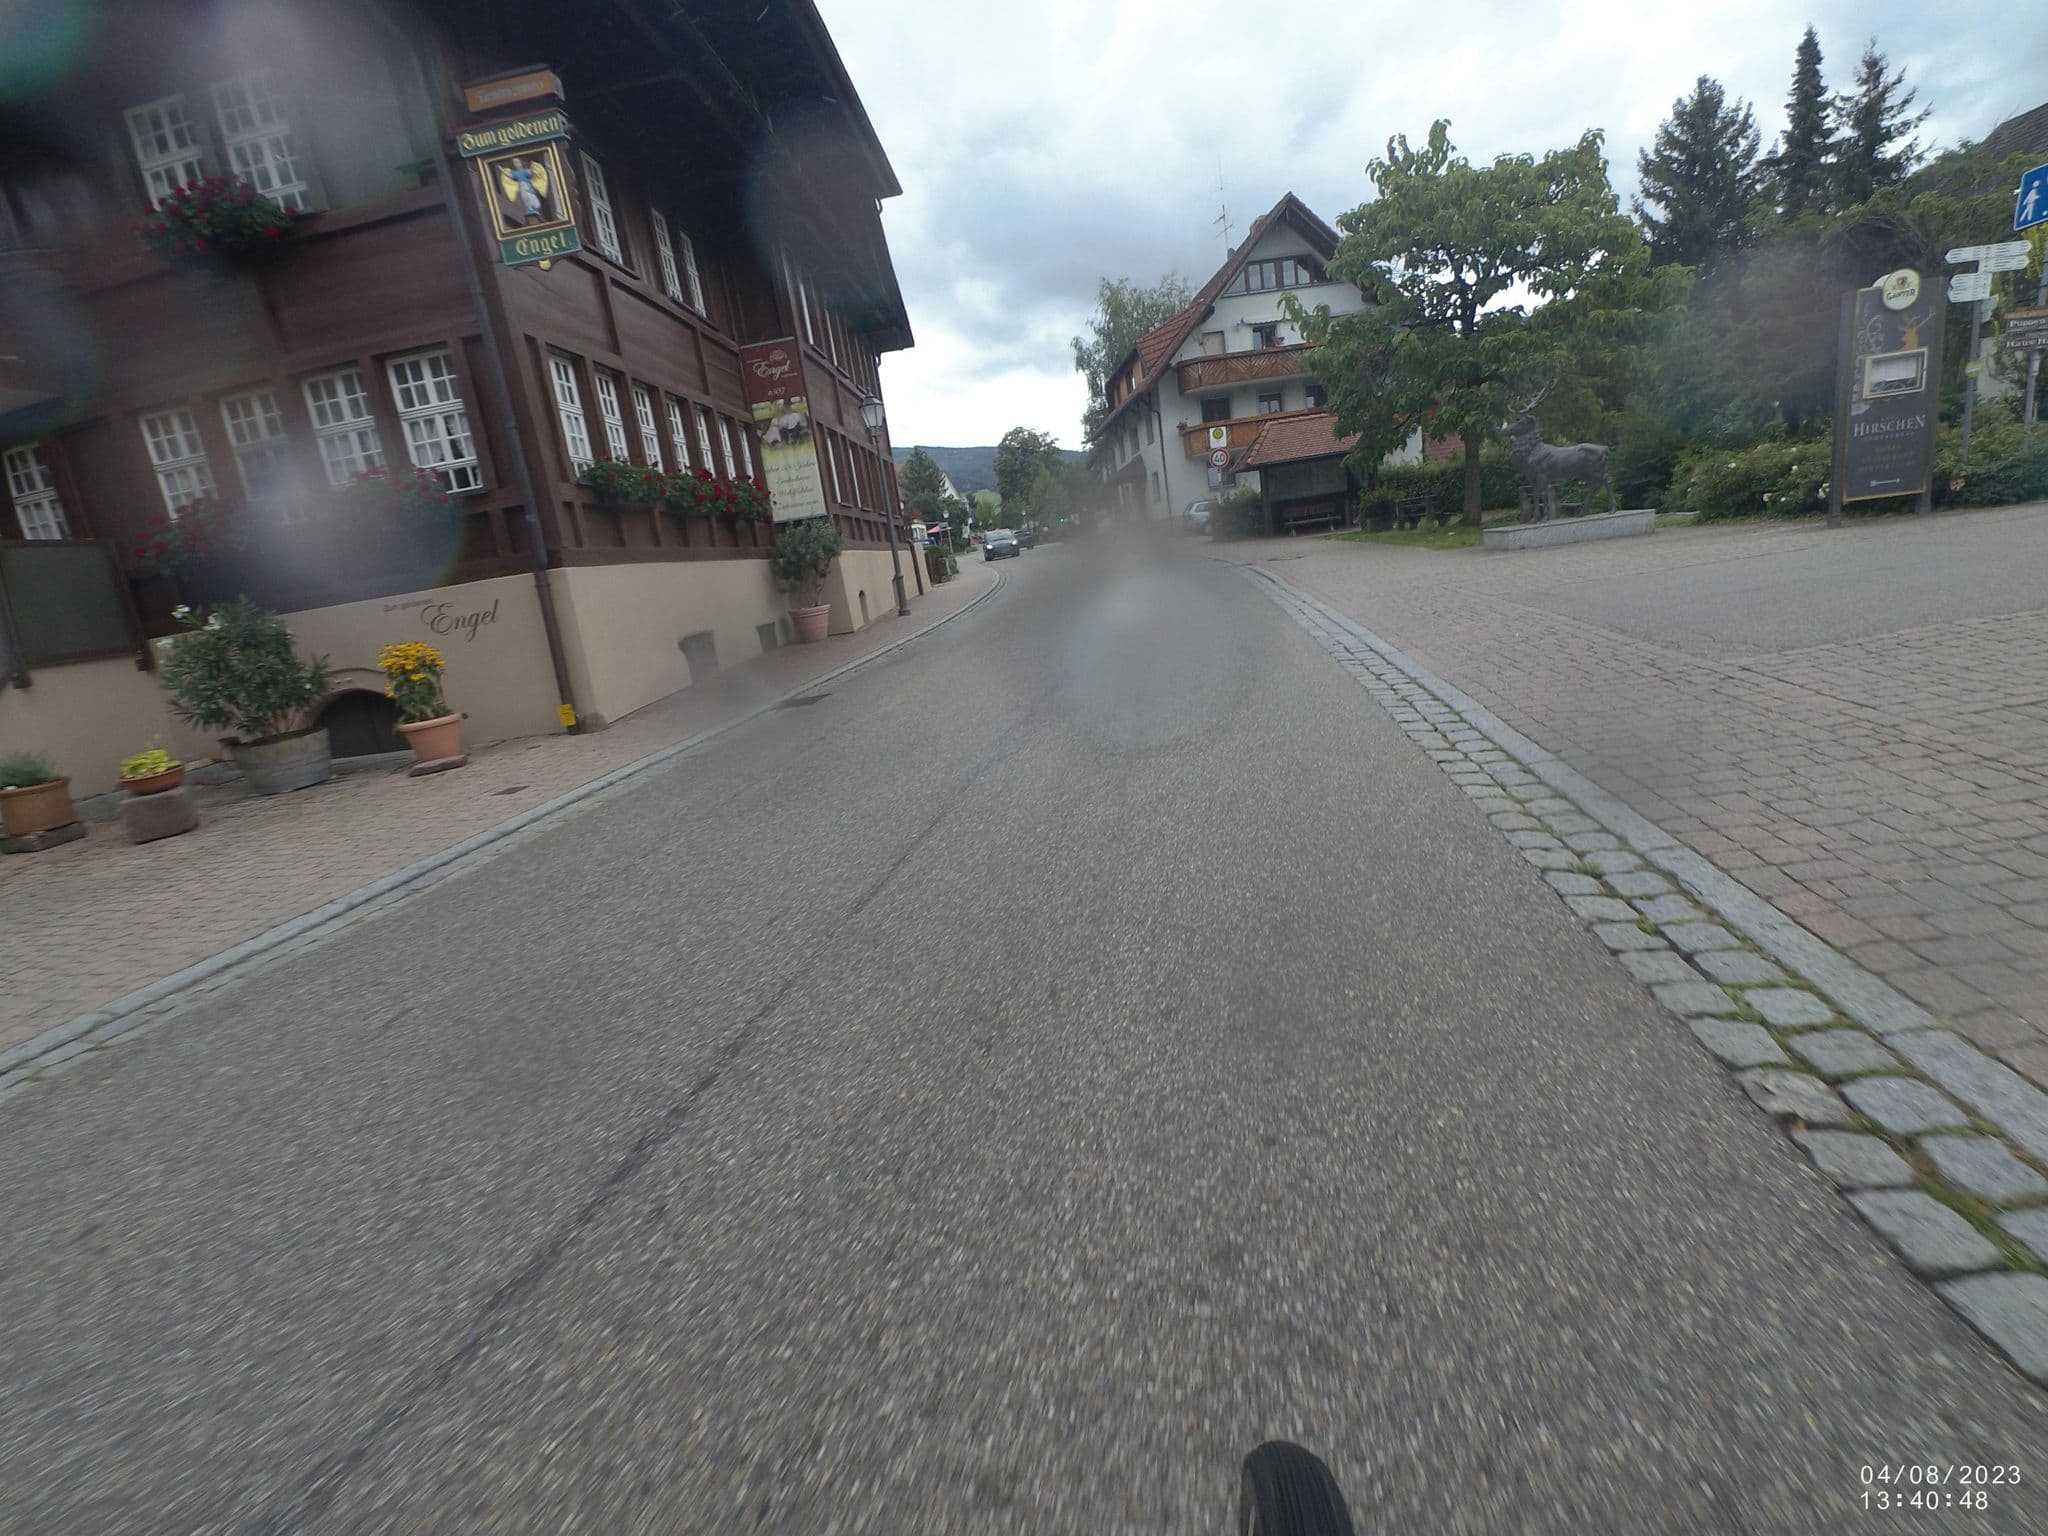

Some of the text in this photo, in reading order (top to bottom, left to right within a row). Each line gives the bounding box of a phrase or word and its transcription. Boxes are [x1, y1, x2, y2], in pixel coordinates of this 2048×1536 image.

[463, 116, 560, 150] Zum goldenen
[515, 231, 567, 256] Engel
[753, 360, 790, 380] Engel
[1854, 414, 1926, 437] HIRSCHEN
[1215, 453, 1224, 462] 40
[421, 599, 497, 642] Engel
